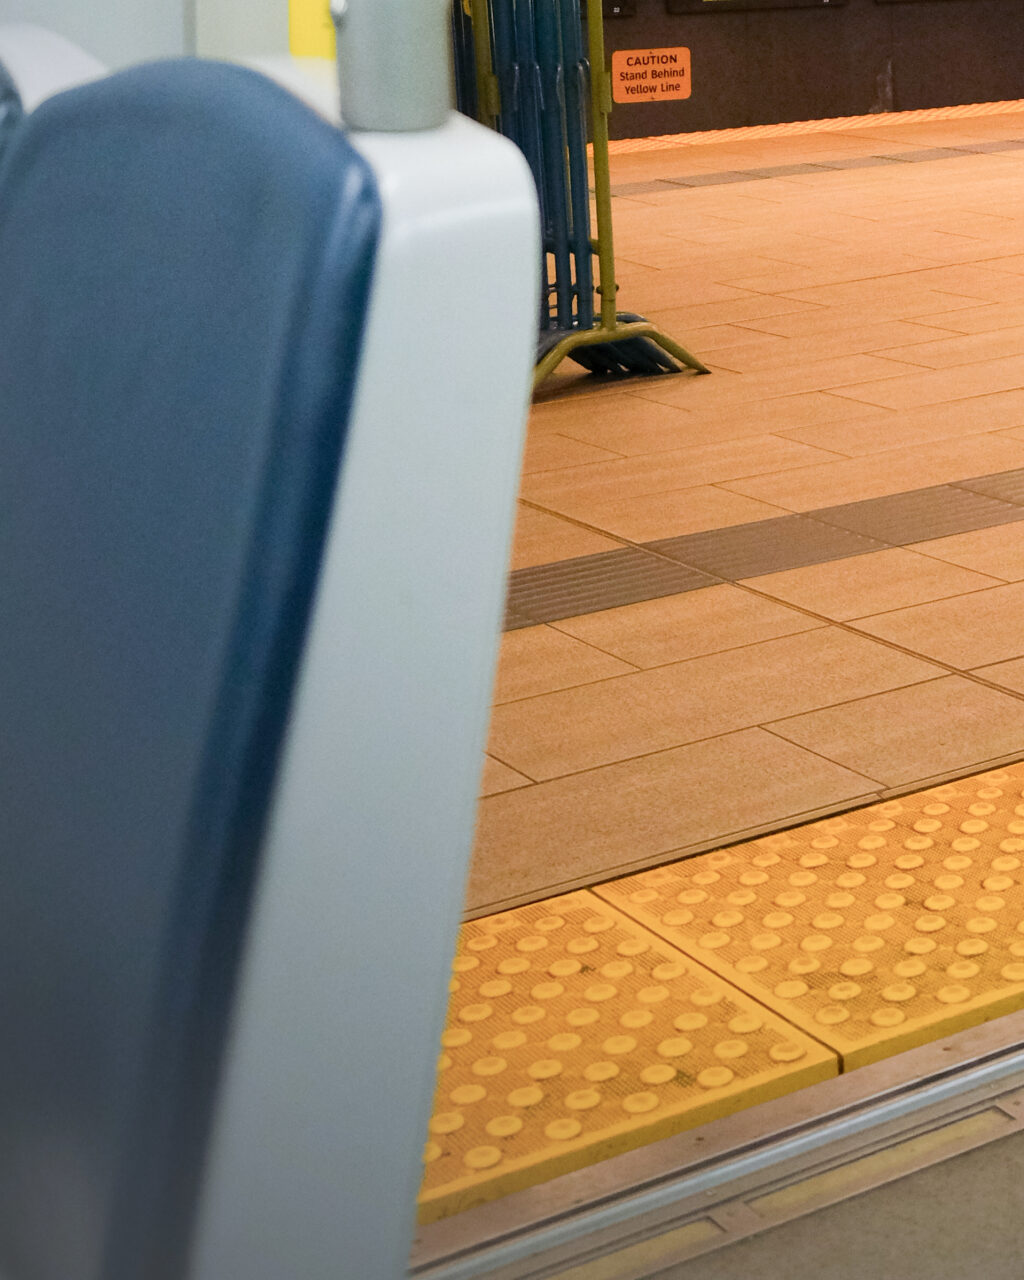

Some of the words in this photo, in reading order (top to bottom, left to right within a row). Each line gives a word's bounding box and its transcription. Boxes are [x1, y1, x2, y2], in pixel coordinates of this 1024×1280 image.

[626, 54, 678, 67] CAUTION
[620, 69, 647, 81] Stand
[651, 67, 685, 79] Behind
[624, 84, 657, 95] Yellow
[660, 81, 681, 93] Line
